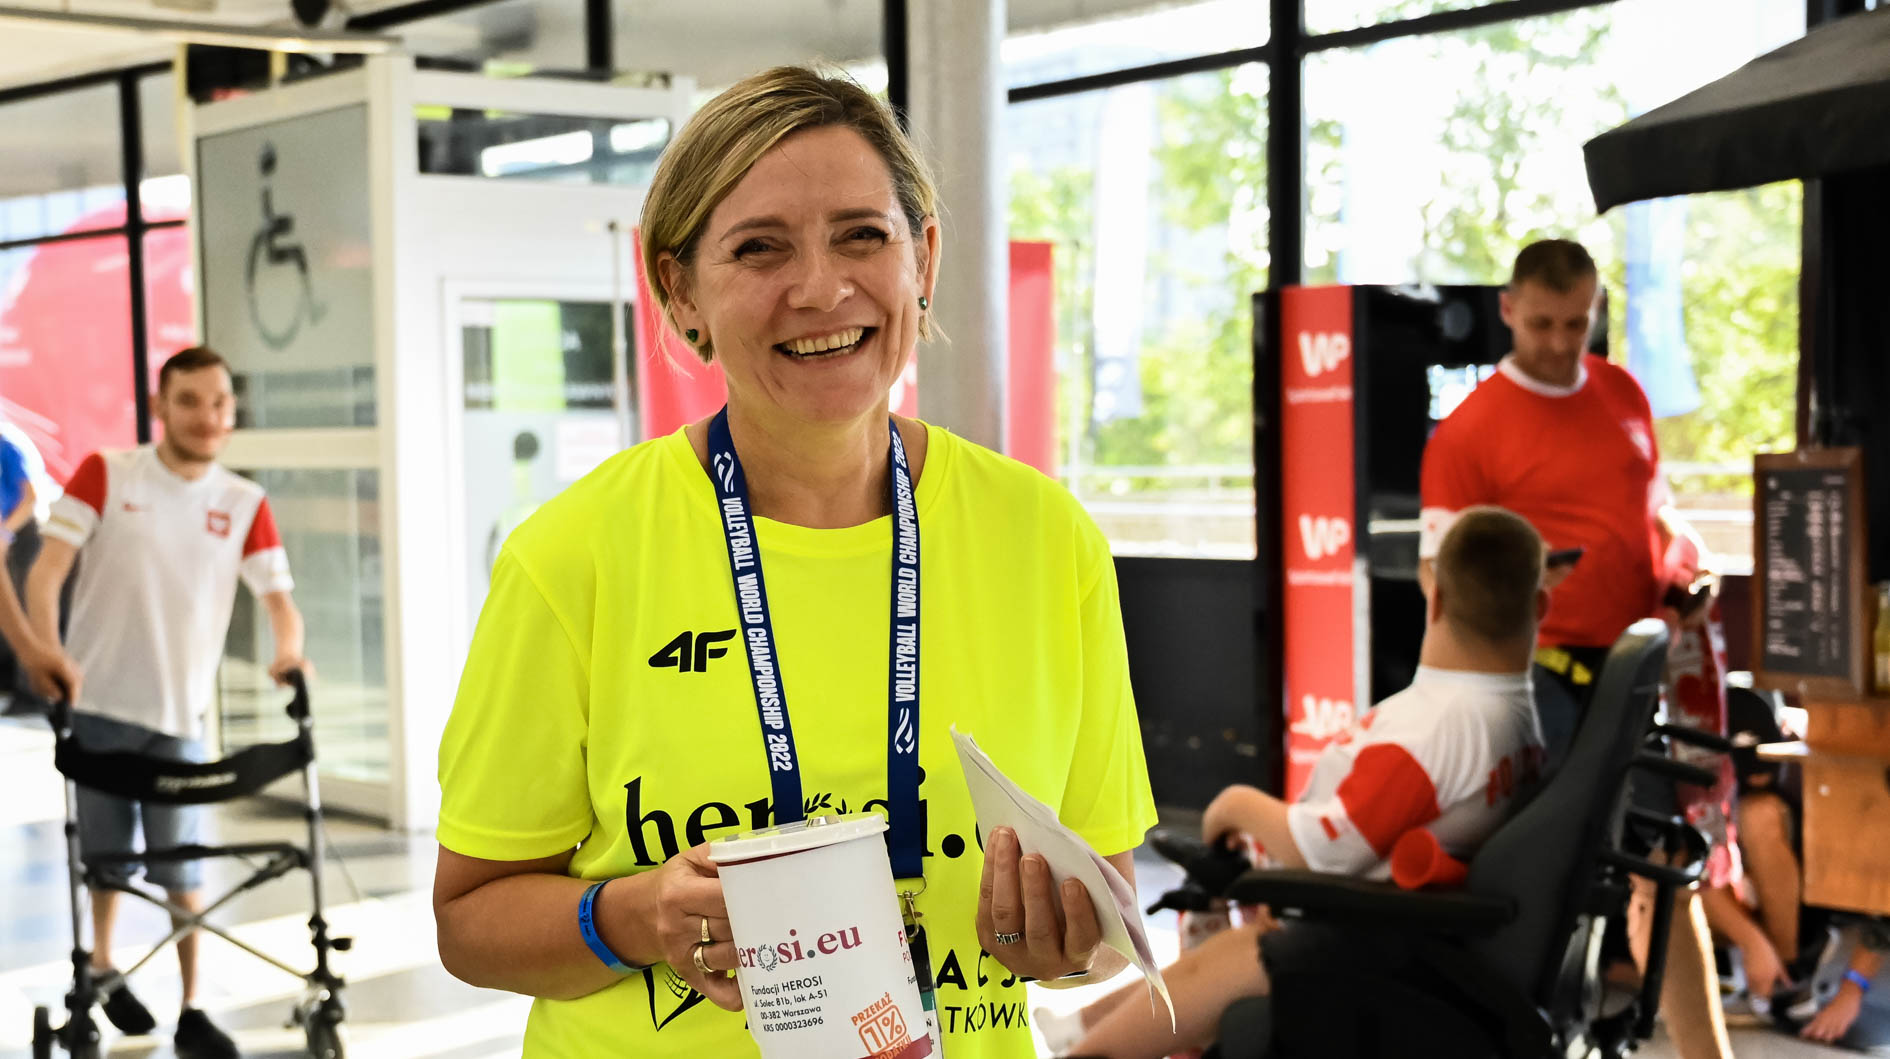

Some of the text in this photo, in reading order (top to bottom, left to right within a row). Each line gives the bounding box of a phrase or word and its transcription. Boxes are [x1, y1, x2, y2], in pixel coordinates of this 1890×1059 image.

[1298, 331, 1350, 377] WP
[1299, 514, 1351, 560] WP
[892, 431, 918, 702] VOLLEYBALL WORLD CHAMPIONSHIP 2022
[648, 629, 737, 673] 4F
[722, 497, 793, 771] VOLLEYBALL WORLD CHAMPIONSHIP 2022
[751, 976, 822, 995] Fundacji HEROSI
[760, 999, 775, 1008] Solec
[776, 997, 792, 1006] 81b,
[794, 994, 806, 1003] lok
[809, 989, 828, 1000] A-51
[760, 1006, 822, 1020] 00-382 Warszawa
[763, 1016, 824, 1032] KRS 0000323696
[851, 992, 893, 1026] PRZEKAŻ
[863, 1010, 903, 1049] 1%
